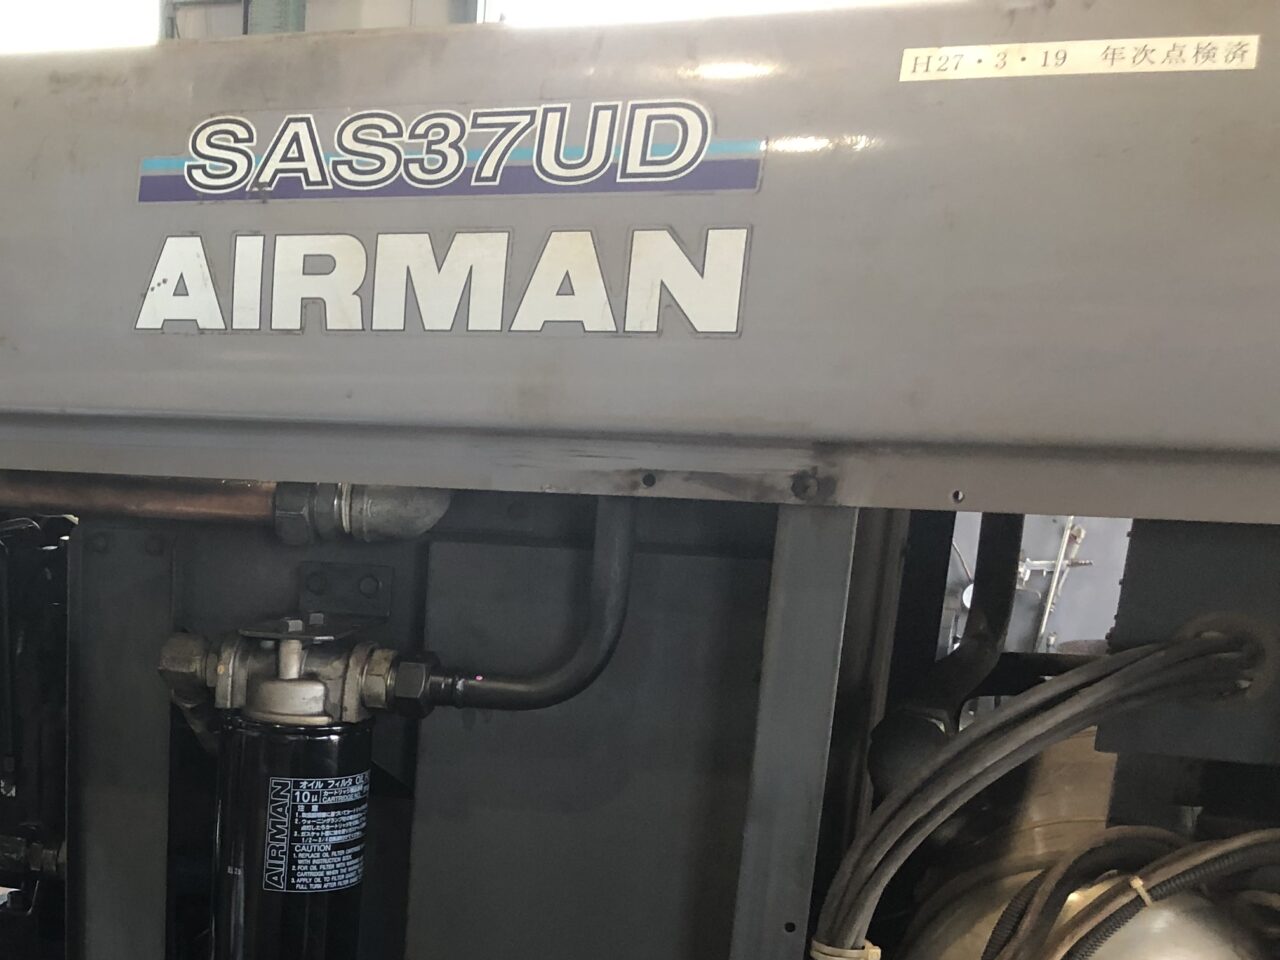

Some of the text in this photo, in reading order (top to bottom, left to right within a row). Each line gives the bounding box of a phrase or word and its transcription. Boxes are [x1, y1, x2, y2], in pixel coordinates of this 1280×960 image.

[1100, 40, 1251, 66] 年次点検済
[186, 99, 712, 195] SAS37UD
[134, 228, 749, 333] AIRMAN
[299, 780, 324, 790] オイル
[327, 777, 353, 790] フィルタ
[265, 779, 292, 889] AIRMAN
[294, 844, 332, 853] CAUTION
